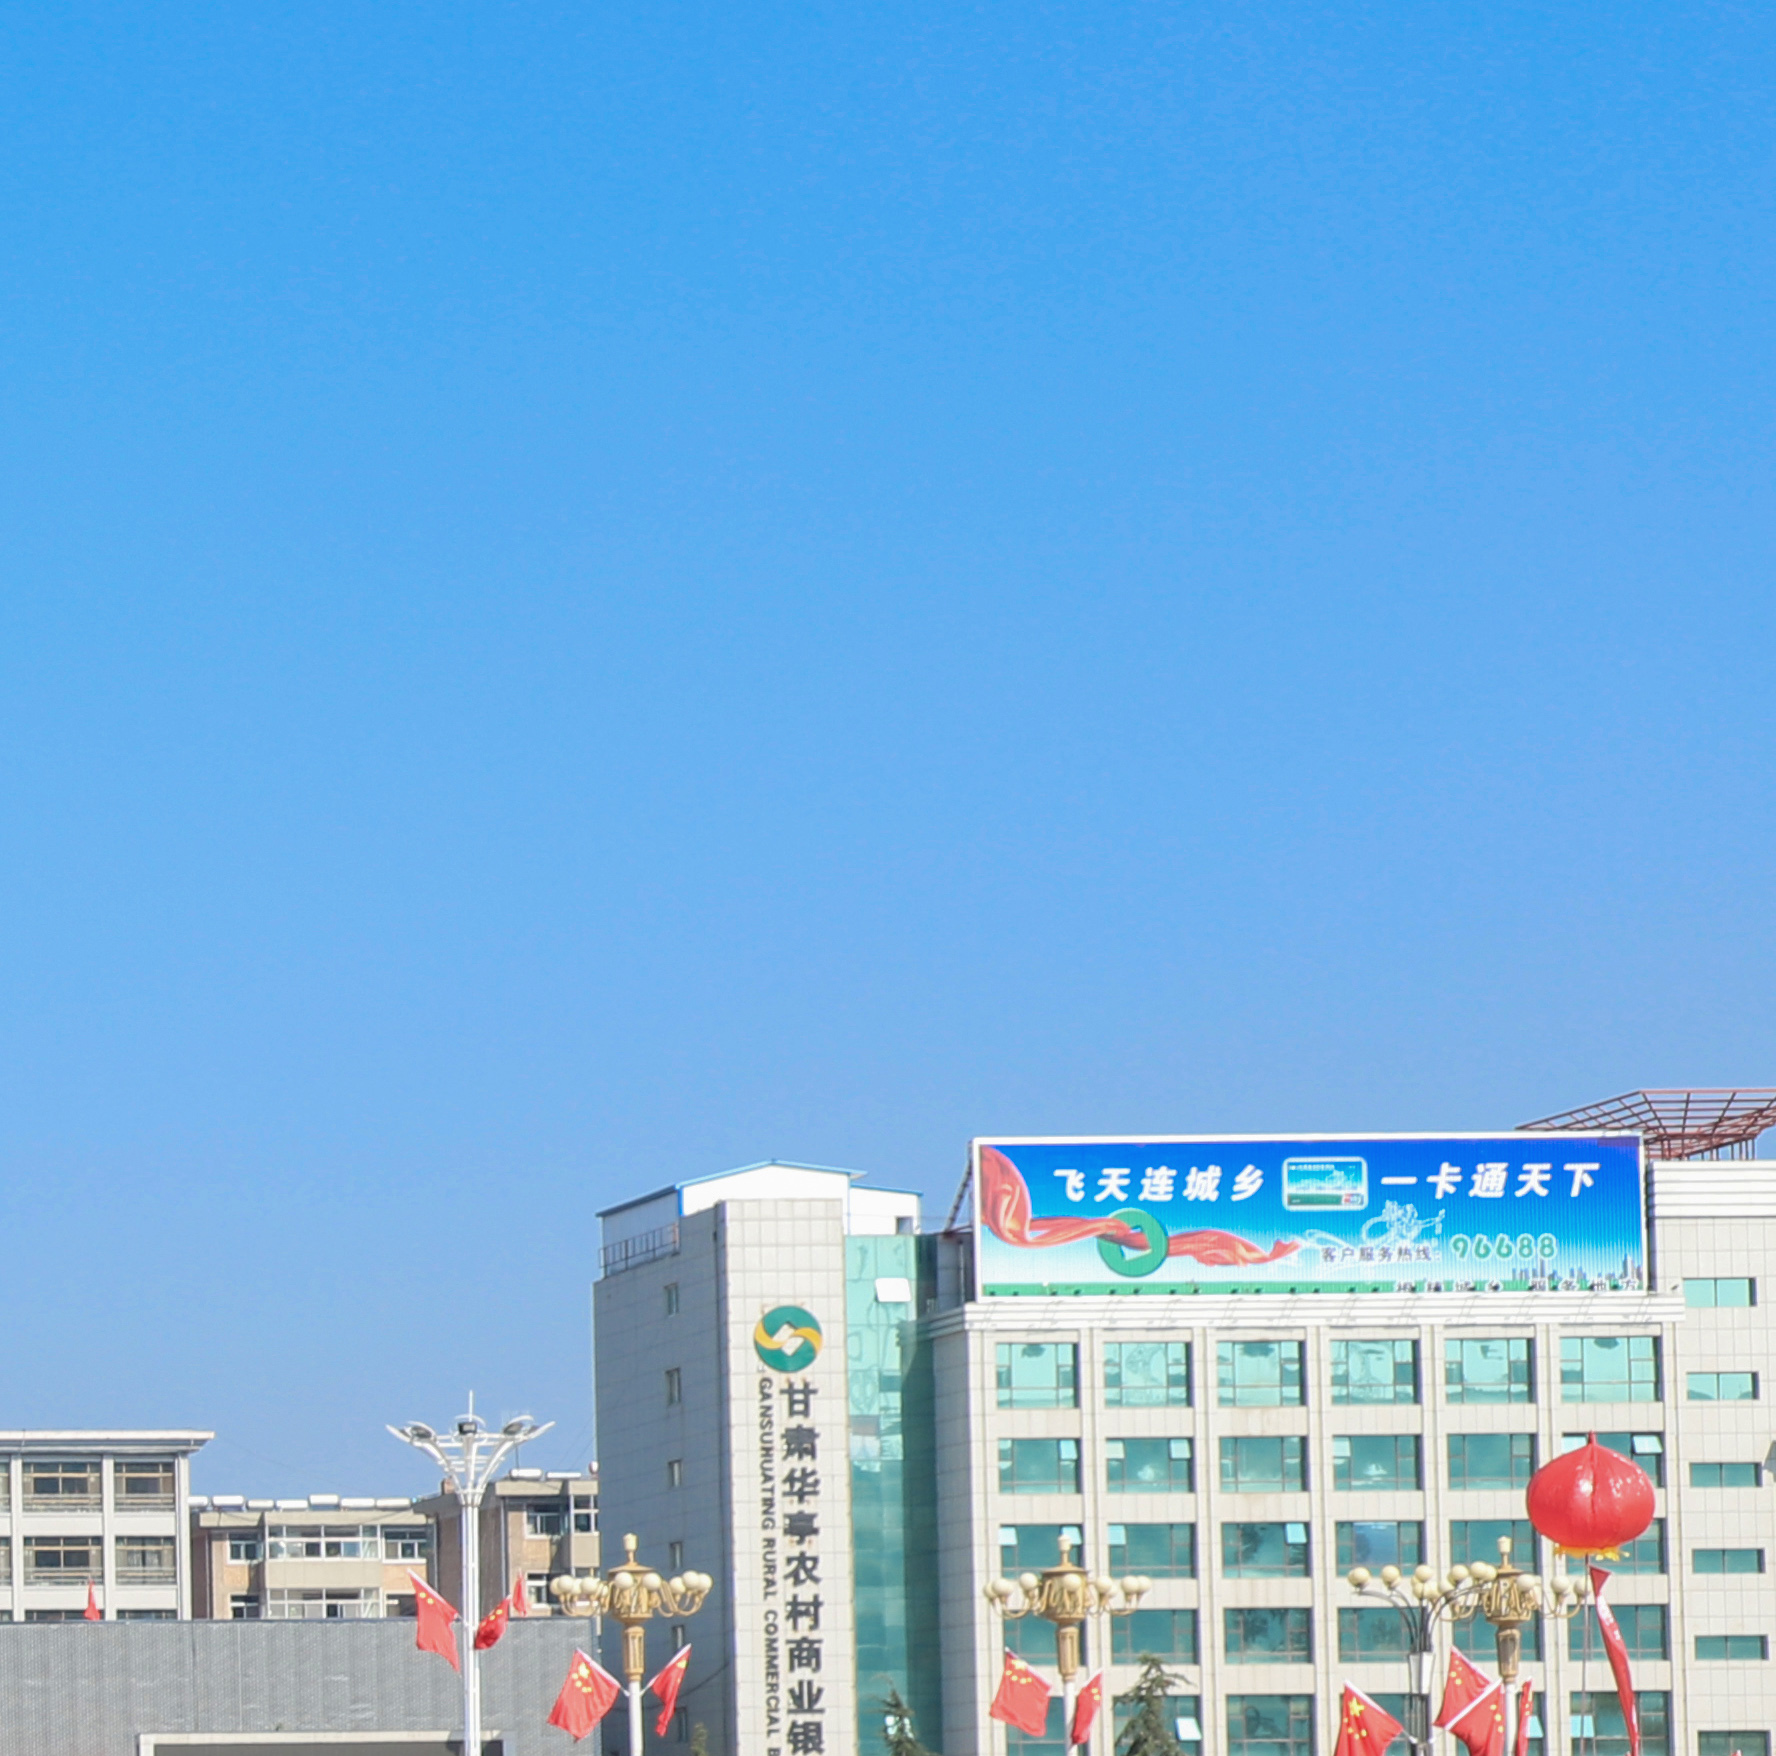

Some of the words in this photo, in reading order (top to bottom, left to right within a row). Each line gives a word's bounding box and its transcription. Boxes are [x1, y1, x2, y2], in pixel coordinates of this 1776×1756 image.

[1052, 1165, 1267, 1203] 飞天连城乡
[1380, 1162, 1601, 1200] 一卡通天下
[1450, 1233, 1558, 1260] 96688
[762, 1537, 777, 1600] RURAL
[764, 1609, 781, 1739] COMMERCIAL
